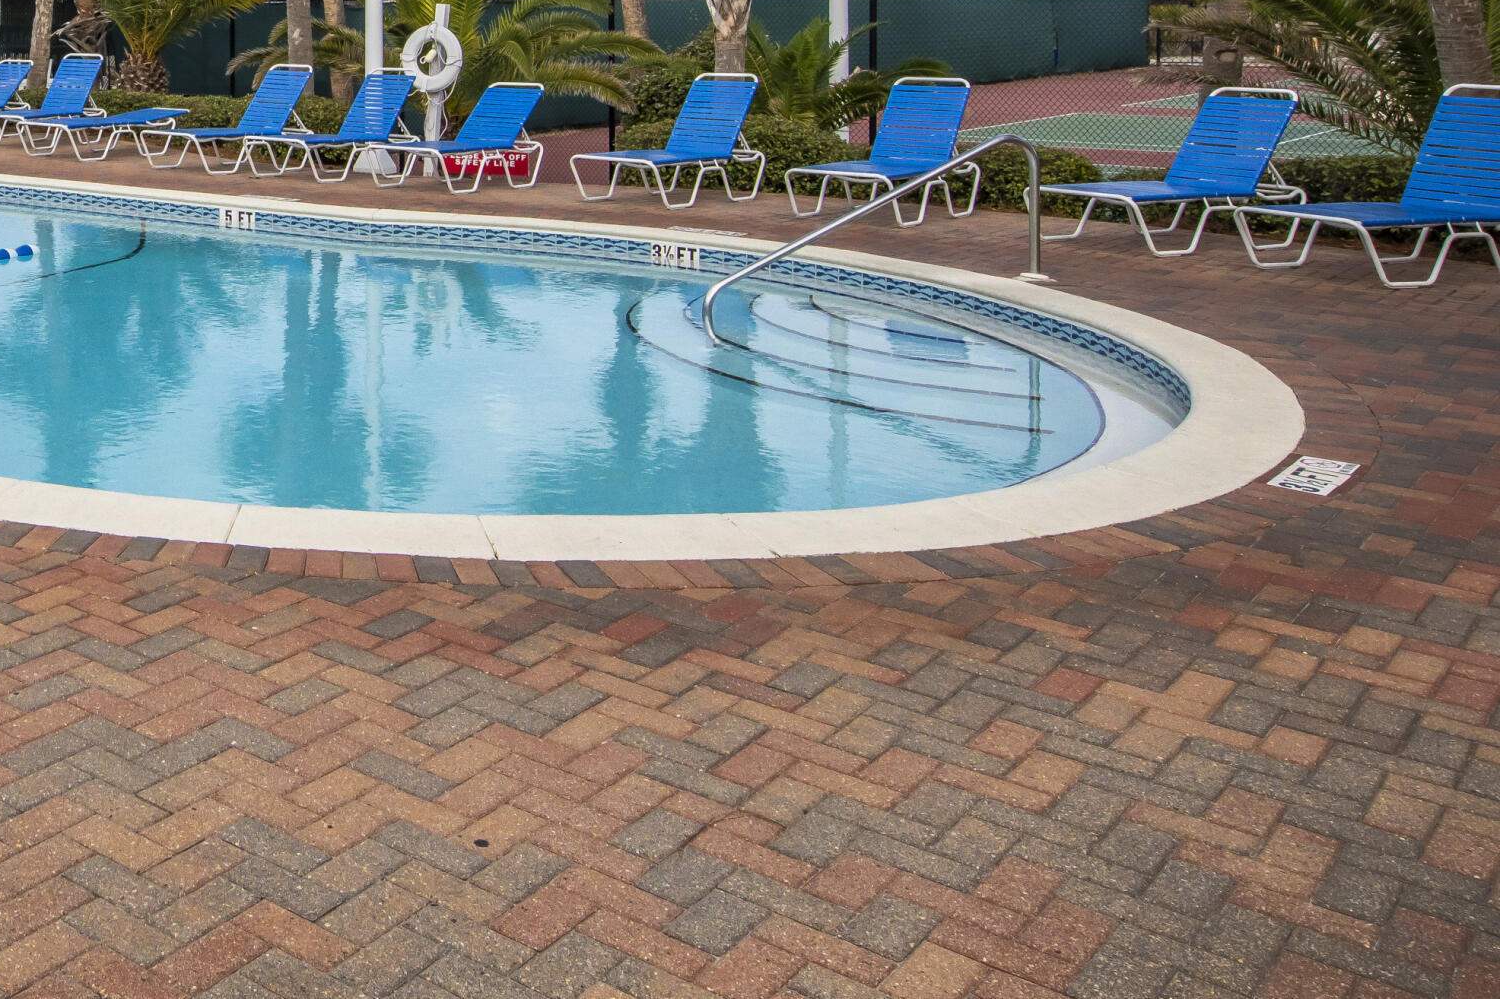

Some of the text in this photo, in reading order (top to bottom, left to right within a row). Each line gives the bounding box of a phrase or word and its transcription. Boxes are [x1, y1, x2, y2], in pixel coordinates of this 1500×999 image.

[508, 153, 527, 161] OFF
[225, 210, 253, 227] 5 FT
[677, 246, 697, 264] FT
